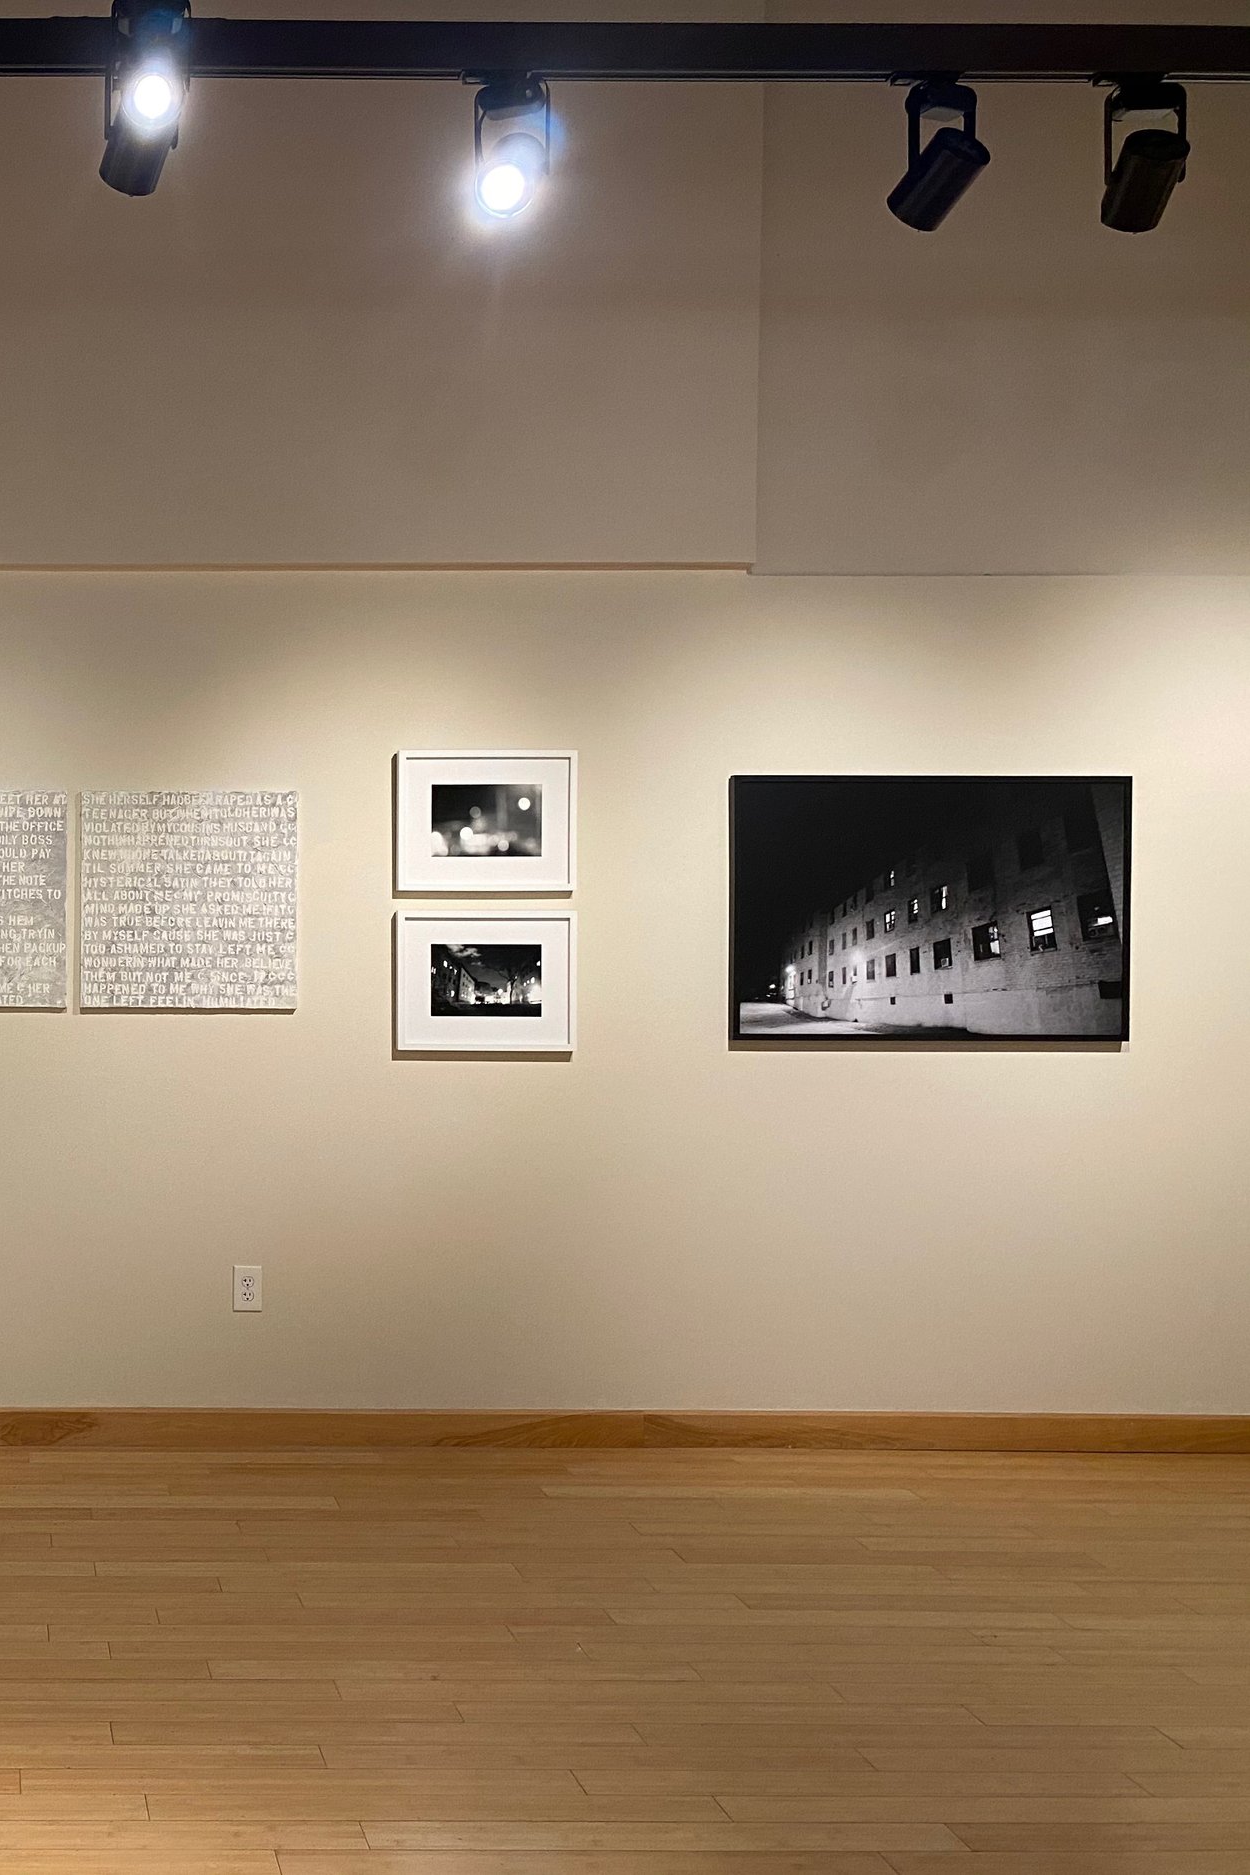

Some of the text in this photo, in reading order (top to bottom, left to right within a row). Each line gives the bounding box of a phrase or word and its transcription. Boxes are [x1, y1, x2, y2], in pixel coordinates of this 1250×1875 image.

[26, 794, 49, 804] HER
[0, 821, 20, 832] THE
[22, 821, 64, 832] OFFICE
[22, 834, 52, 846] BOSS
[32, 848, 52, 858] PAY
[3, 861, 25, 872] HER
[237, 863, 251, 874] TO
[19, 875, 46, 886] NOTE
[47, 888, 61, 899] TO
[112, 916, 142, 928] TRUE
[20, 928, 54, 939] TRYIN
[84, 930, 98, 941] BY
[102, 930, 149, 941] MYSELF
[250, 930, 282, 941] JUST
[169, 944, 182, 954] TO
[26, 956, 56, 967] EACH
